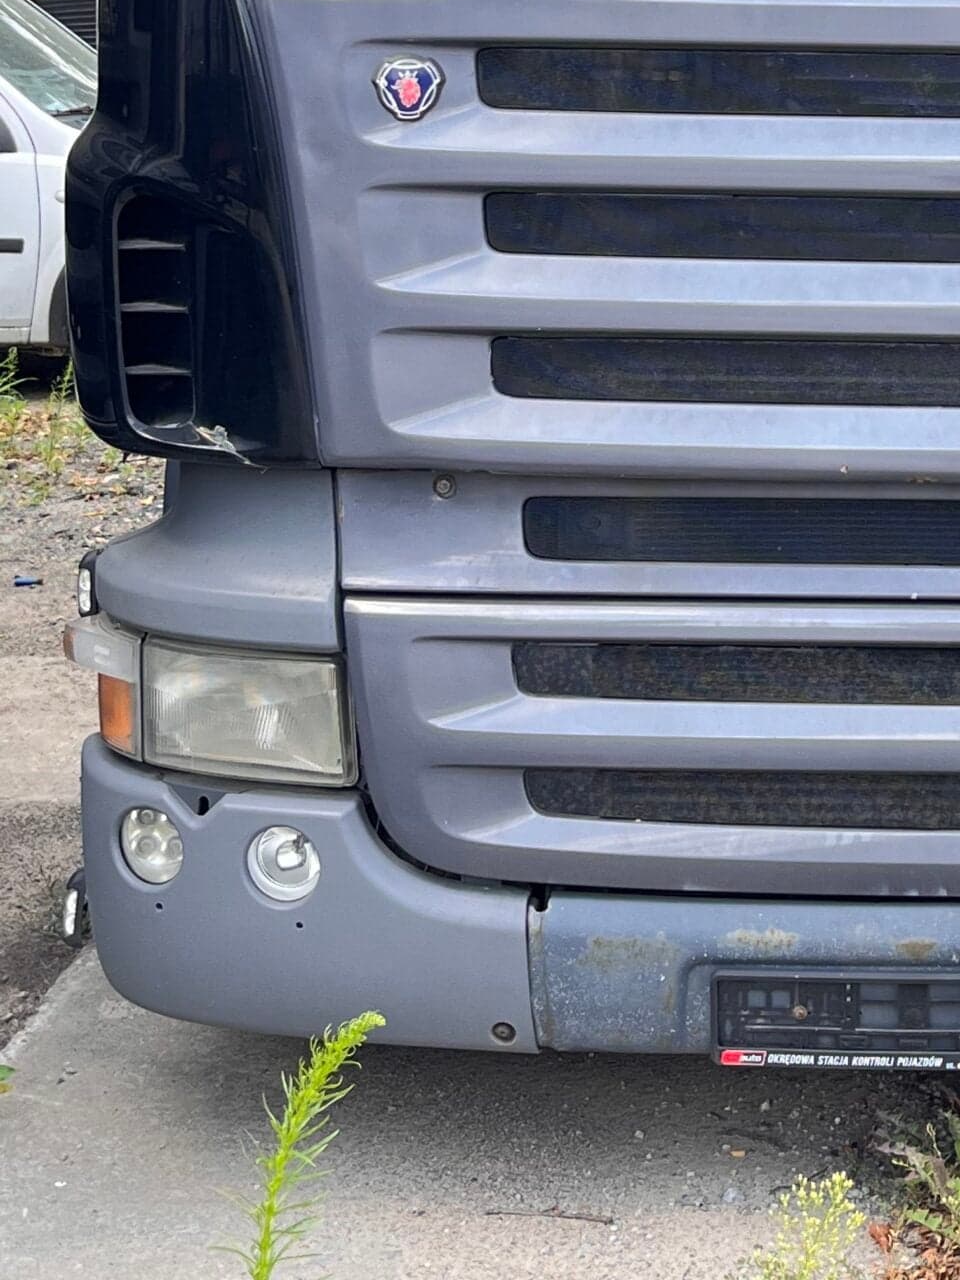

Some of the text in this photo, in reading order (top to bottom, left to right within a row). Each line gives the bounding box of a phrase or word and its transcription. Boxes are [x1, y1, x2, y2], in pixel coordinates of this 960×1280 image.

[817, 1055, 848, 1066] STACJA
[851, 1056, 895, 1067] KONTROLI
[897, 1055, 943, 1067] POJAZDÓW
